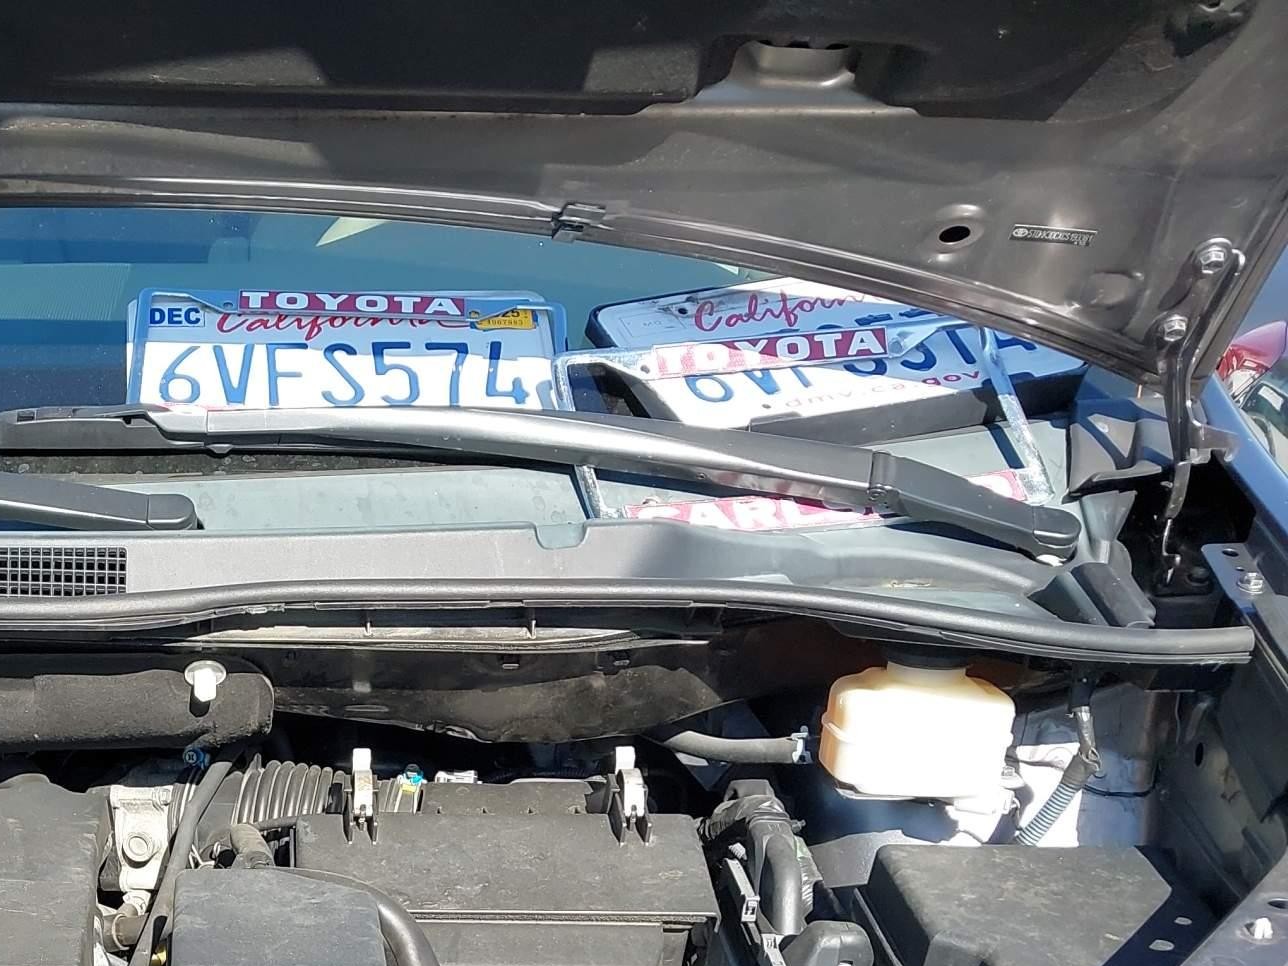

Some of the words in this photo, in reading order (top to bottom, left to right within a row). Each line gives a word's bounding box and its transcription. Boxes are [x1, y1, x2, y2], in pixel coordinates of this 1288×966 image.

[149, 307, 202, 326] DEC
[241, 291, 462, 316] TOYOTA
[657, 330, 885, 374] TOYOTA
[158, 339, 531, 407] 6VFS574
